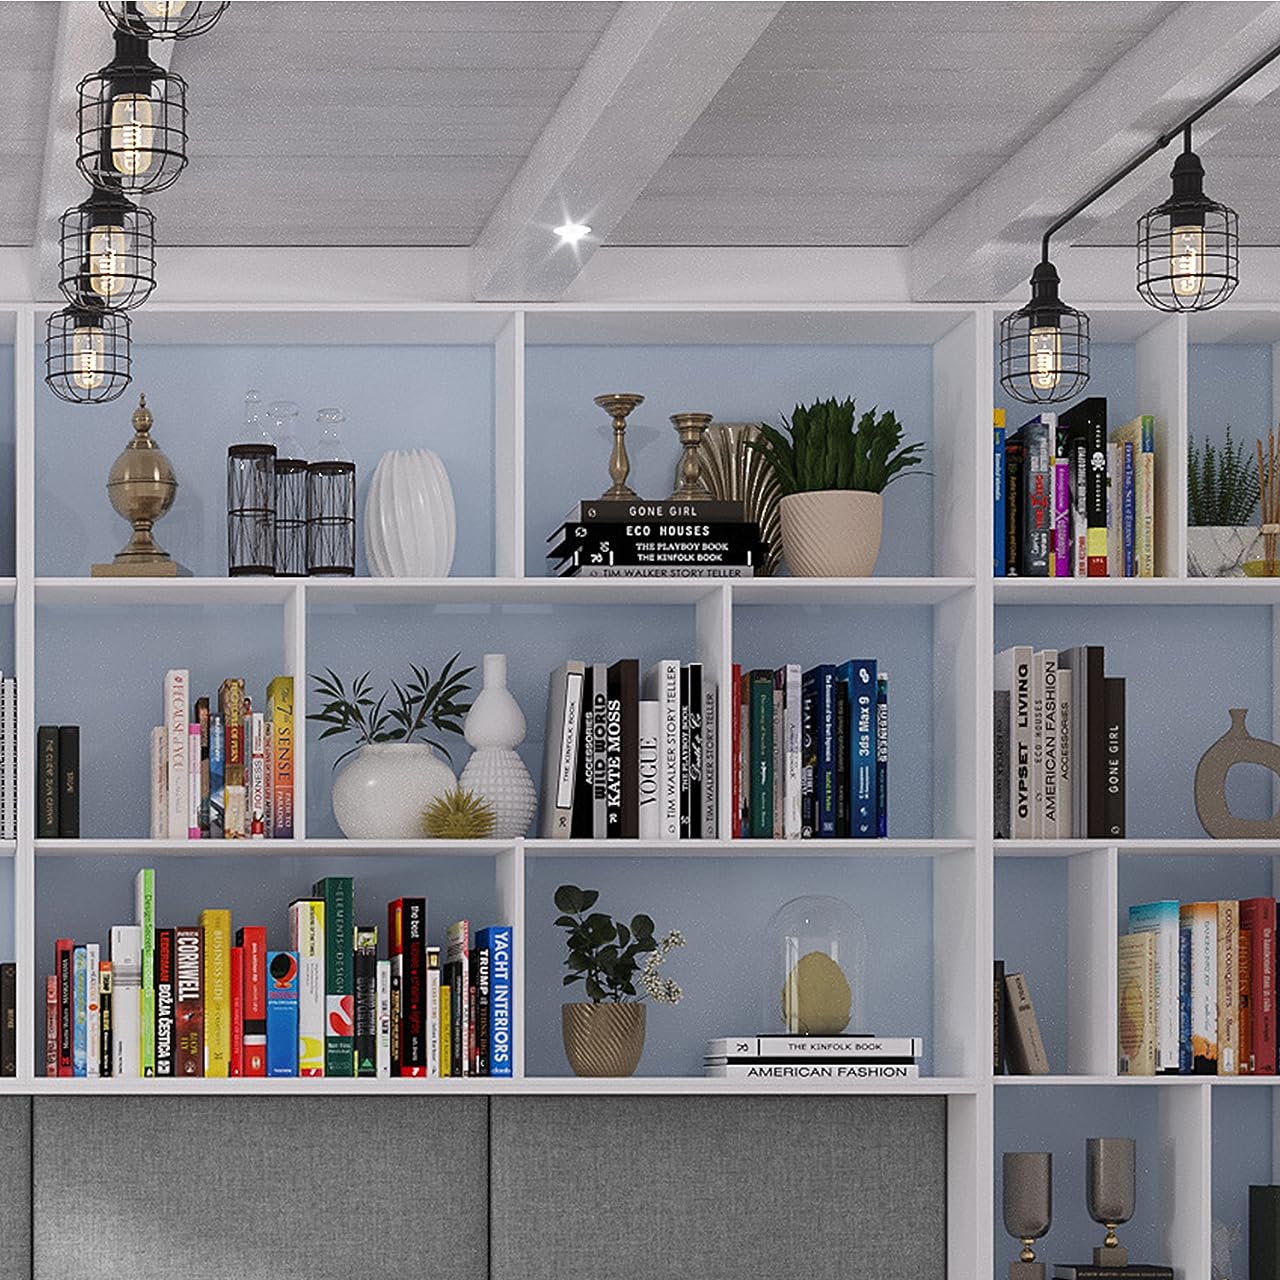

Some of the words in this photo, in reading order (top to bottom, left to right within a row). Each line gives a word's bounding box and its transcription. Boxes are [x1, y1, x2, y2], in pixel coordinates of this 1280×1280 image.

[629, 506, 663, 516] GONE
[669, 506, 698, 516] GIRL
[626, 526, 651, 536] ECO
[659, 526, 710, 536] HOUSES
[635, 543, 655, 551] THE
[657, 543, 700, 551] PLAYBOY
[702, 543, 729, 551] BOOK
[603, 569, 620, 577] TIM
[624, 569, 669, 577] WALKER
[671, 569, 703, 577] STORY
[705, 569, 741, 577] TELLER
[637, 554, 654, 562] THE
[657, 554, 695, 562] KINFOLK
[697, 554, 723, 562] BOOK
[667, 665, 676, 703] TELLER
[859, 695, 870, 705] 9
[1018, 664, 1028, 727] LIVING
[1046, 661, 1056, 731] FASHION
[568, 700, 576, 725] BOOK
[595, 693, 606, 753] WORLD
[608, 700, 621, 752] MOSS
[667, 707, 676, 744] STORY
[859, 707, 870, 732] Max
[1034, 699, 1042, 738] HOUSES
[565, 727, 573, 763] KINFOLK
[859, 735, 870, 757] 3ds
[1034, 745, 1042, 763] ECO
[1061, 702, 1069, 781] ACCESSORIES
[1109, 724, 1119, 753] GIRL
[595, 759, 606, 800] WILD
[608, 756, 621, 807] KATE
[640, 737, 657, 807] VOGUE
[667, 747, 676, 796] WALKER
[1018, 742, 1028, 819] GYPSET
[1046, 736, 1056, 822] AMERICAN
[1109, 759, 1119, 793] GONE
[667, 799, 676, 819] TIM
[410, 920, 420, 938] best
[159, 931, 169, 982] LEDERMAN
[178, 937, 199, 1002] CORNWELL
[336, 952, 344, 993] DESIGN
[479, 949, 489, 995] TRUMP
[495, 932, 508, 978] YACHT
[495, 985, 508, 1062] INTERIORS
[788, 1043, 806, 1051] THE
[810, 1043, 851, 1051] KINFOLK
[855, 1043, 882, 1051] BOOK
[747, 1067, 832, 1077] AMERICAN
[837, 1067, 907, 1077] FASHION
